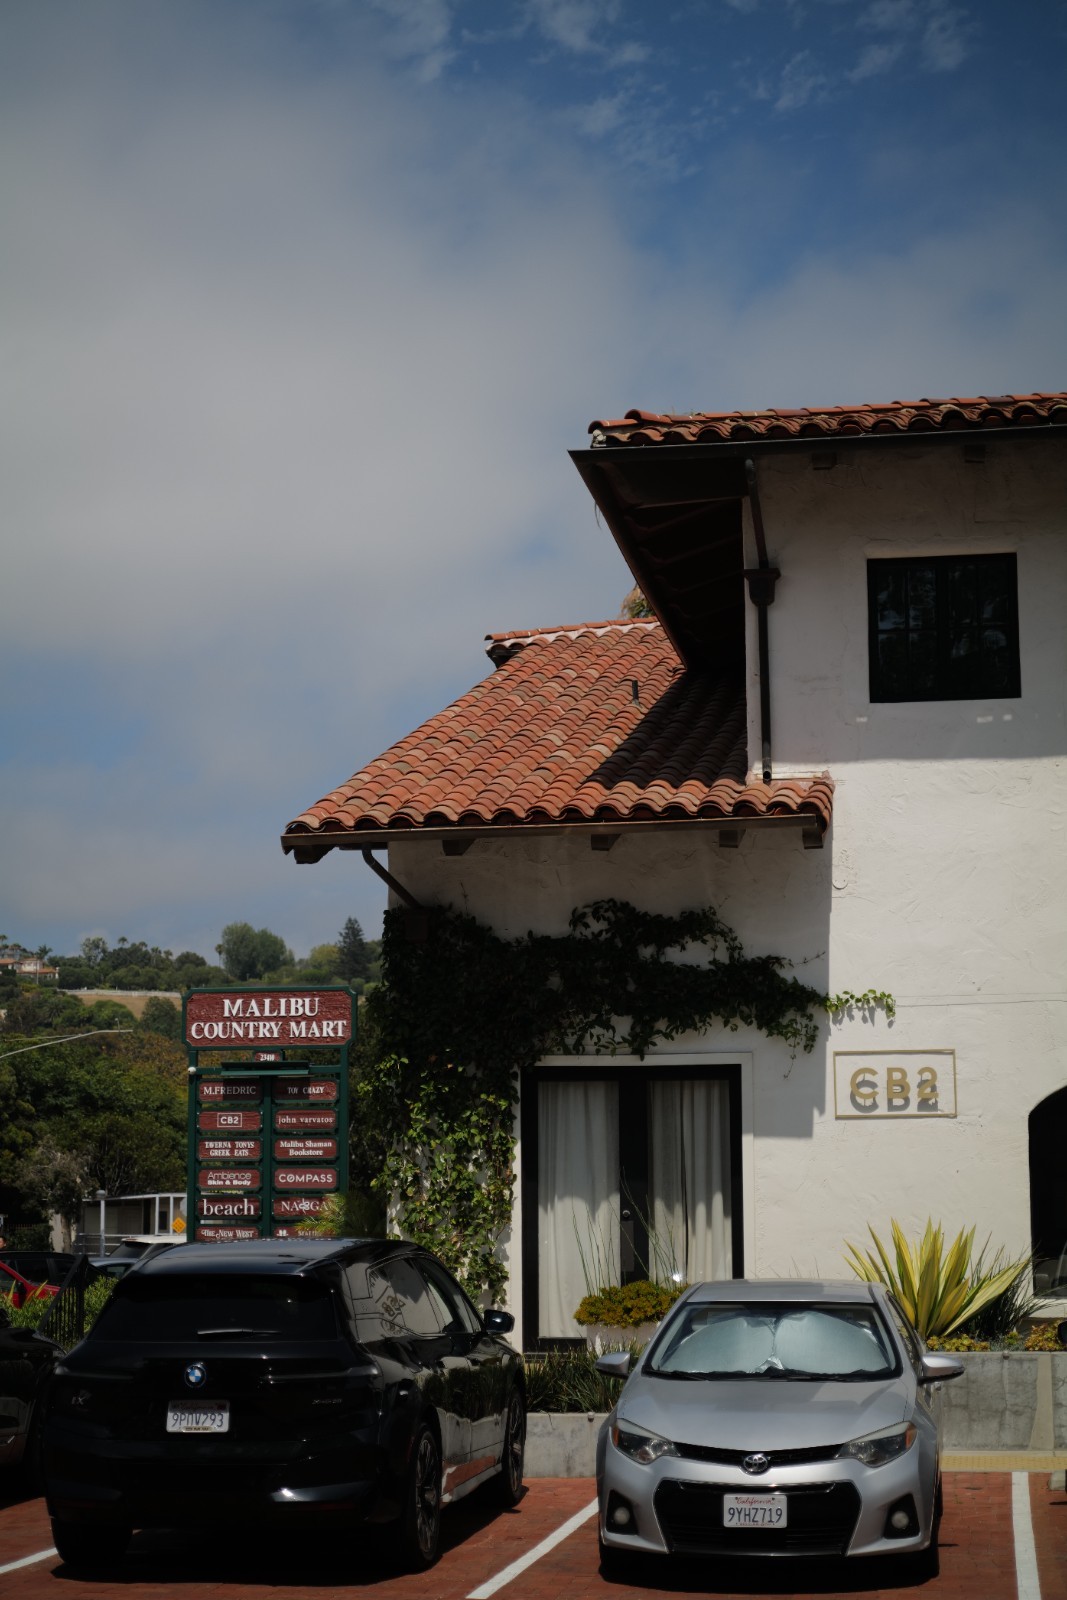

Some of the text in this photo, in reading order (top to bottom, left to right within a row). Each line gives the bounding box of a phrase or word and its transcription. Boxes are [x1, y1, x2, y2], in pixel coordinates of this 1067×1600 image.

[223, 998, 320, 1017] MALIBU
[191, 1020, 347, 1039] COUNTRY MART
[850, 1066, 939, 1100] CB2
[203, 1086, 256, 1095] M.FREDRIC
[220, 1116, 239, 1124] CB2
[278, 1115, 296, 1124] john
[279, 1140, 332, 1148] Malibu Shaman
[207, 1171, 252, 1180] Ambience
[278, 1174, 333, 1183] COMPASS
[202, 1198, 255, 1216] beach
[736, 1497, 773, 1506] California
[728, 1507, 783, 1523] 9YHZ719
